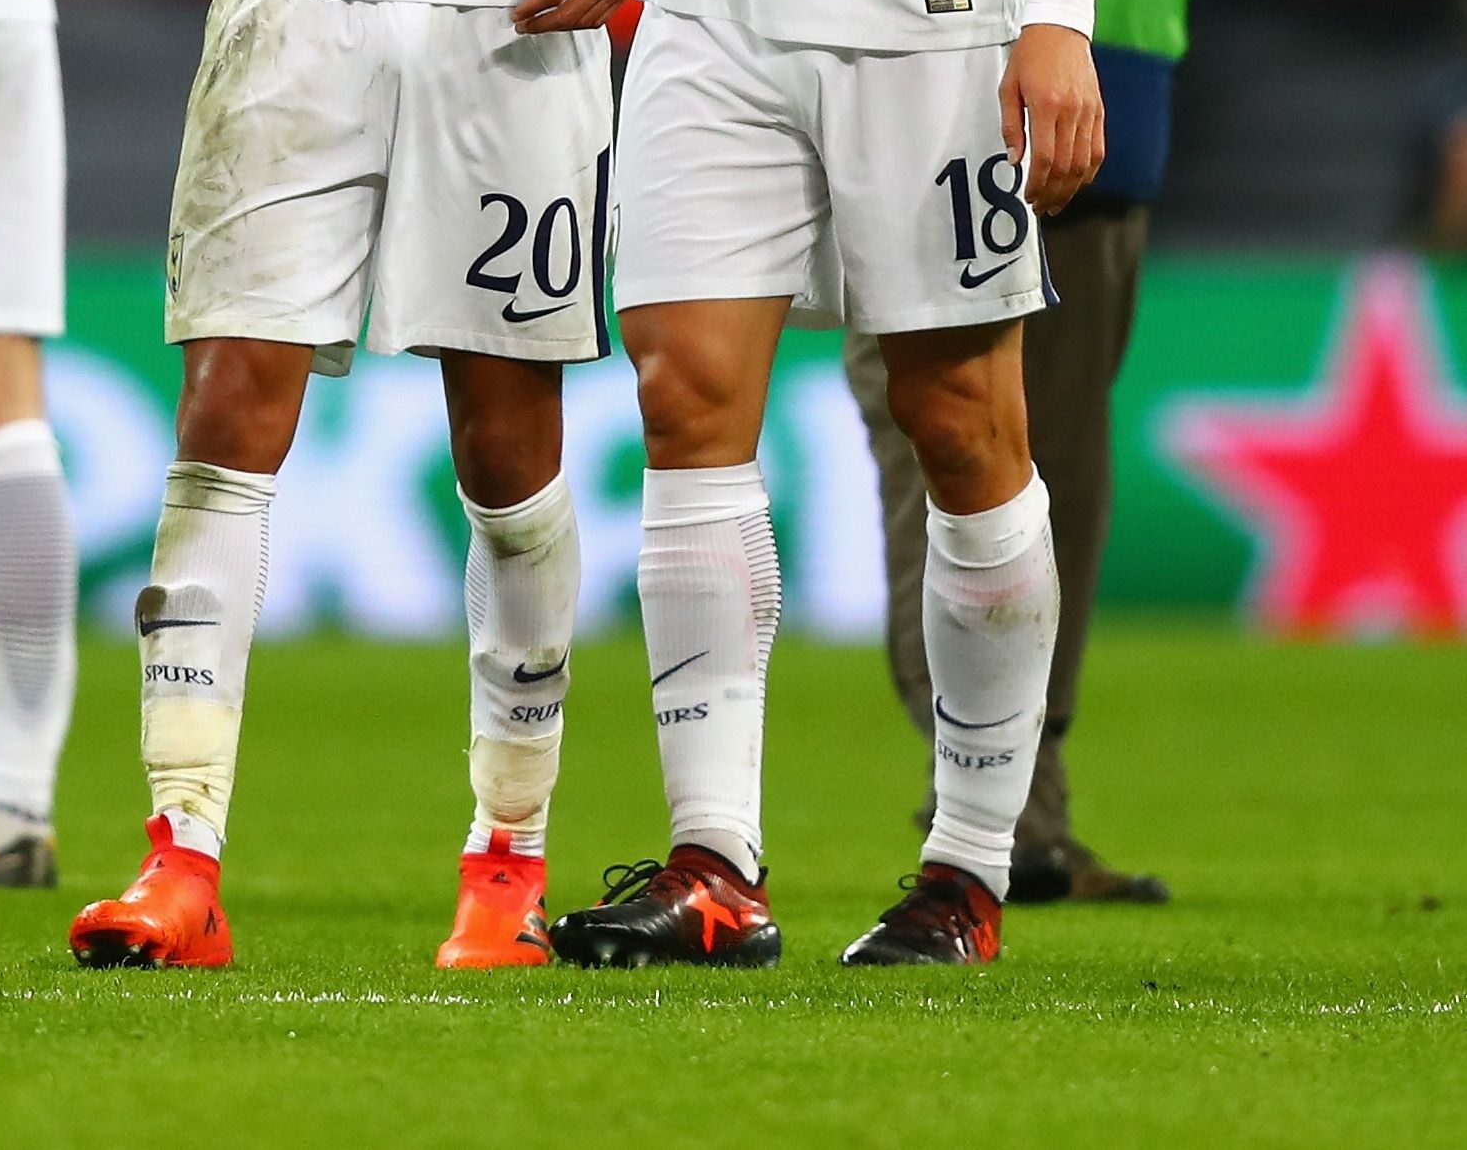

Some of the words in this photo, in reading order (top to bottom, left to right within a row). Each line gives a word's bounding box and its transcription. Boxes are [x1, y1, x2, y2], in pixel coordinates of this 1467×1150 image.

[935, 152, 1030, 261] 18
[465, 192, 582, 299] 20
[144, 663, 215, 686] SPURS
[656, 702, 710, 726] URS
